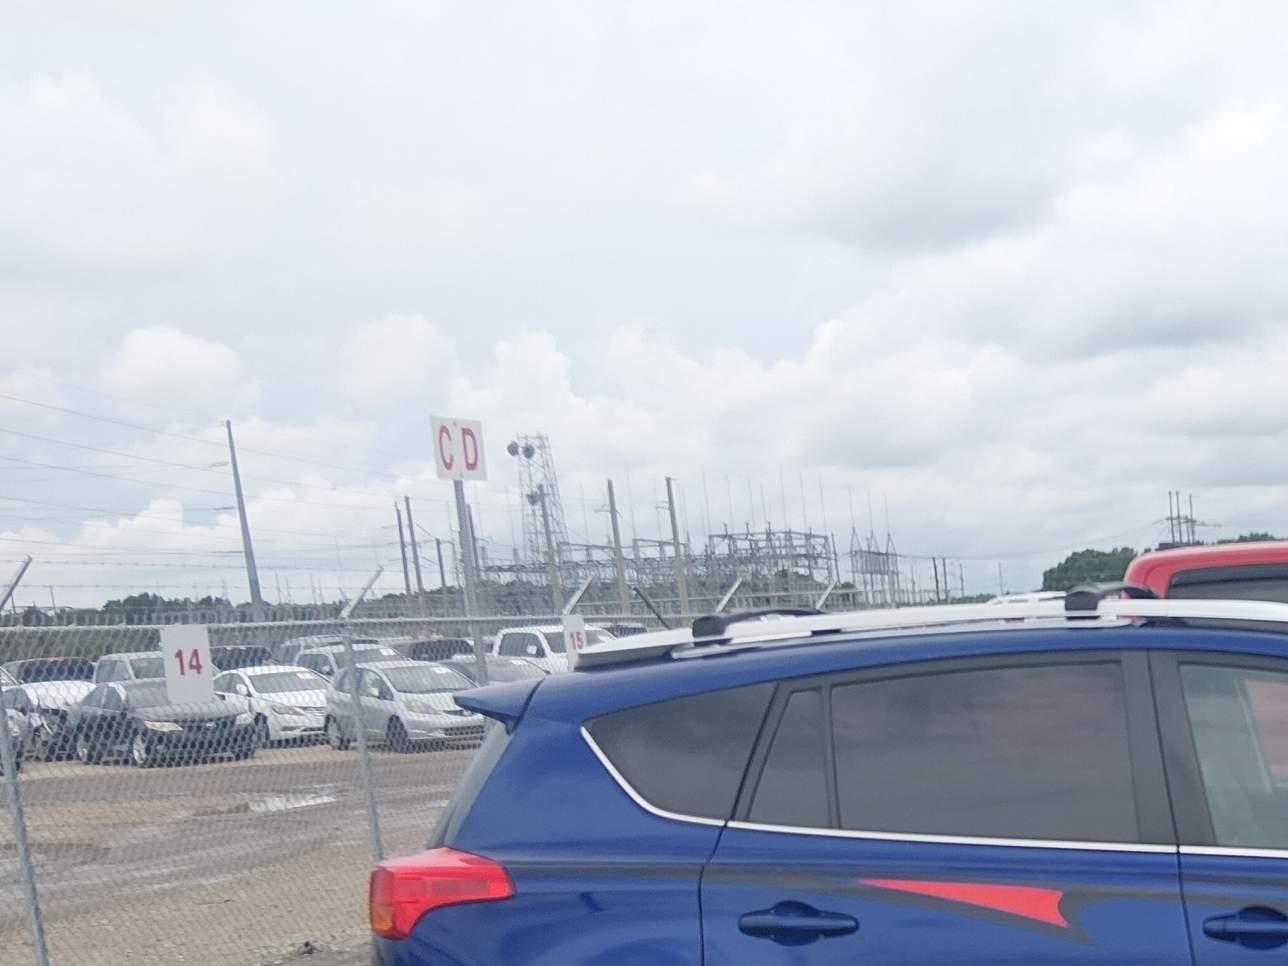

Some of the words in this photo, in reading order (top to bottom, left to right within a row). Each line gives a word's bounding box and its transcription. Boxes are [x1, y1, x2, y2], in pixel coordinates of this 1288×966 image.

[438, 425, 454, 471] C
[461, 427, 478, 471] D
[570, 631, 584, 650] 15
[175, 649, 202, 675] 14
